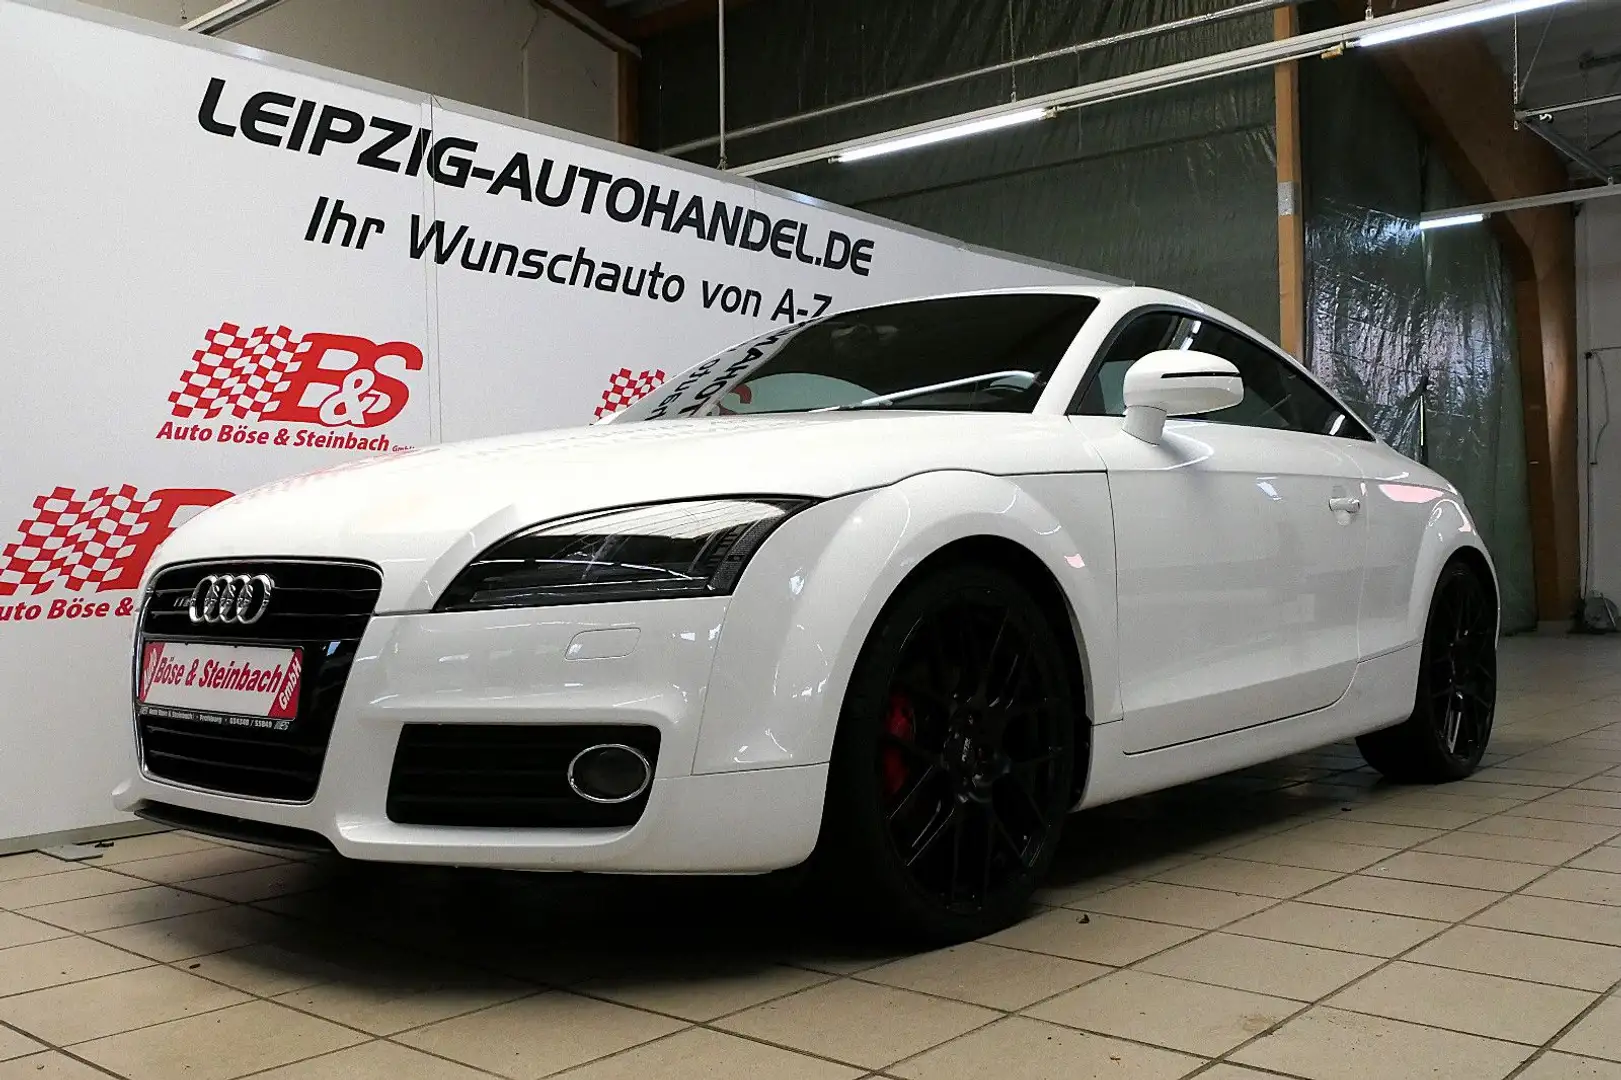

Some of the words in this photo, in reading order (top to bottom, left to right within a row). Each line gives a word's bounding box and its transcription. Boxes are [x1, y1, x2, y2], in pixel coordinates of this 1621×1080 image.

[197, 77, 875, 277] LEIPZIG-AUTOHANDEL.DE
[305, 196, 385, 250] Ihr
[409, 213, 685, 303] Wunschauto
[702, 279, 762, 318] von
[769, 287, 833, 324] A-Z
[259, 331, 424, 429] B&S
[156, 421, 214, 442] Auto
[217, 424, 270, 446] Böse
[273, 428, 290, 446] &
[293, 430, 390, 452] Steinbach
[0, 602, 42, 622] uto
[47, 597, 110, 620] Böse
[114, 596, 134, 617] &
[153, 655, 185, 686] Böse
[184, 658, 200, 687] &
[198, 659, 284, 694] Steinbach
[278, 656, 303, 711] GmbH
